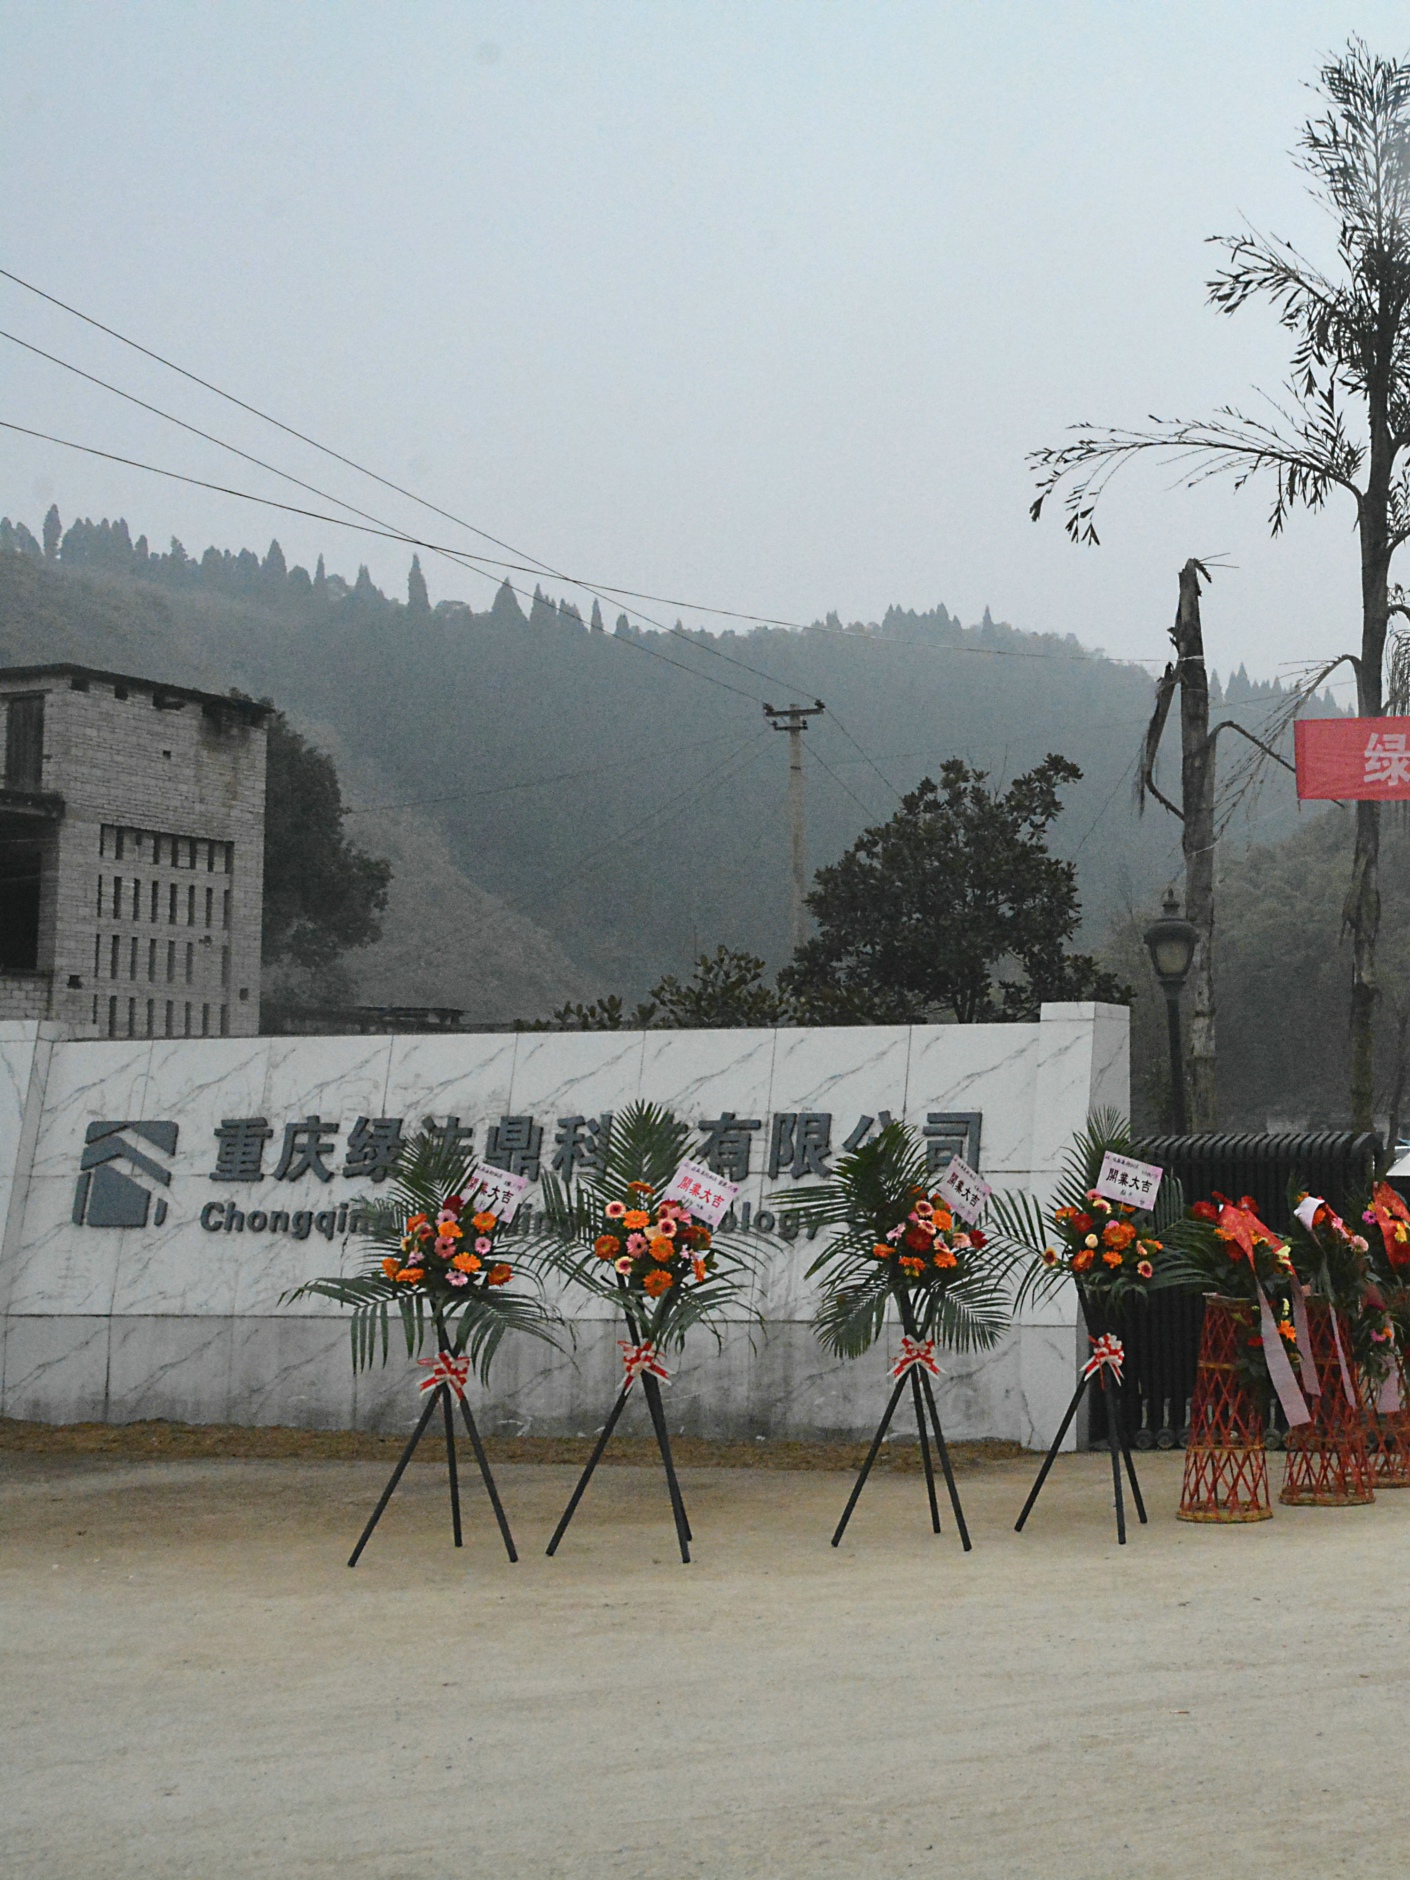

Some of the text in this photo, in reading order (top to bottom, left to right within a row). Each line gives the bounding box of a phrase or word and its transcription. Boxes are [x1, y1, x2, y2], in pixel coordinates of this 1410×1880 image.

[209, 1110, 983, 1183] 重庆绿法鼎科有限司
[1106, 1167, 1153, 1194] 開業大吉
